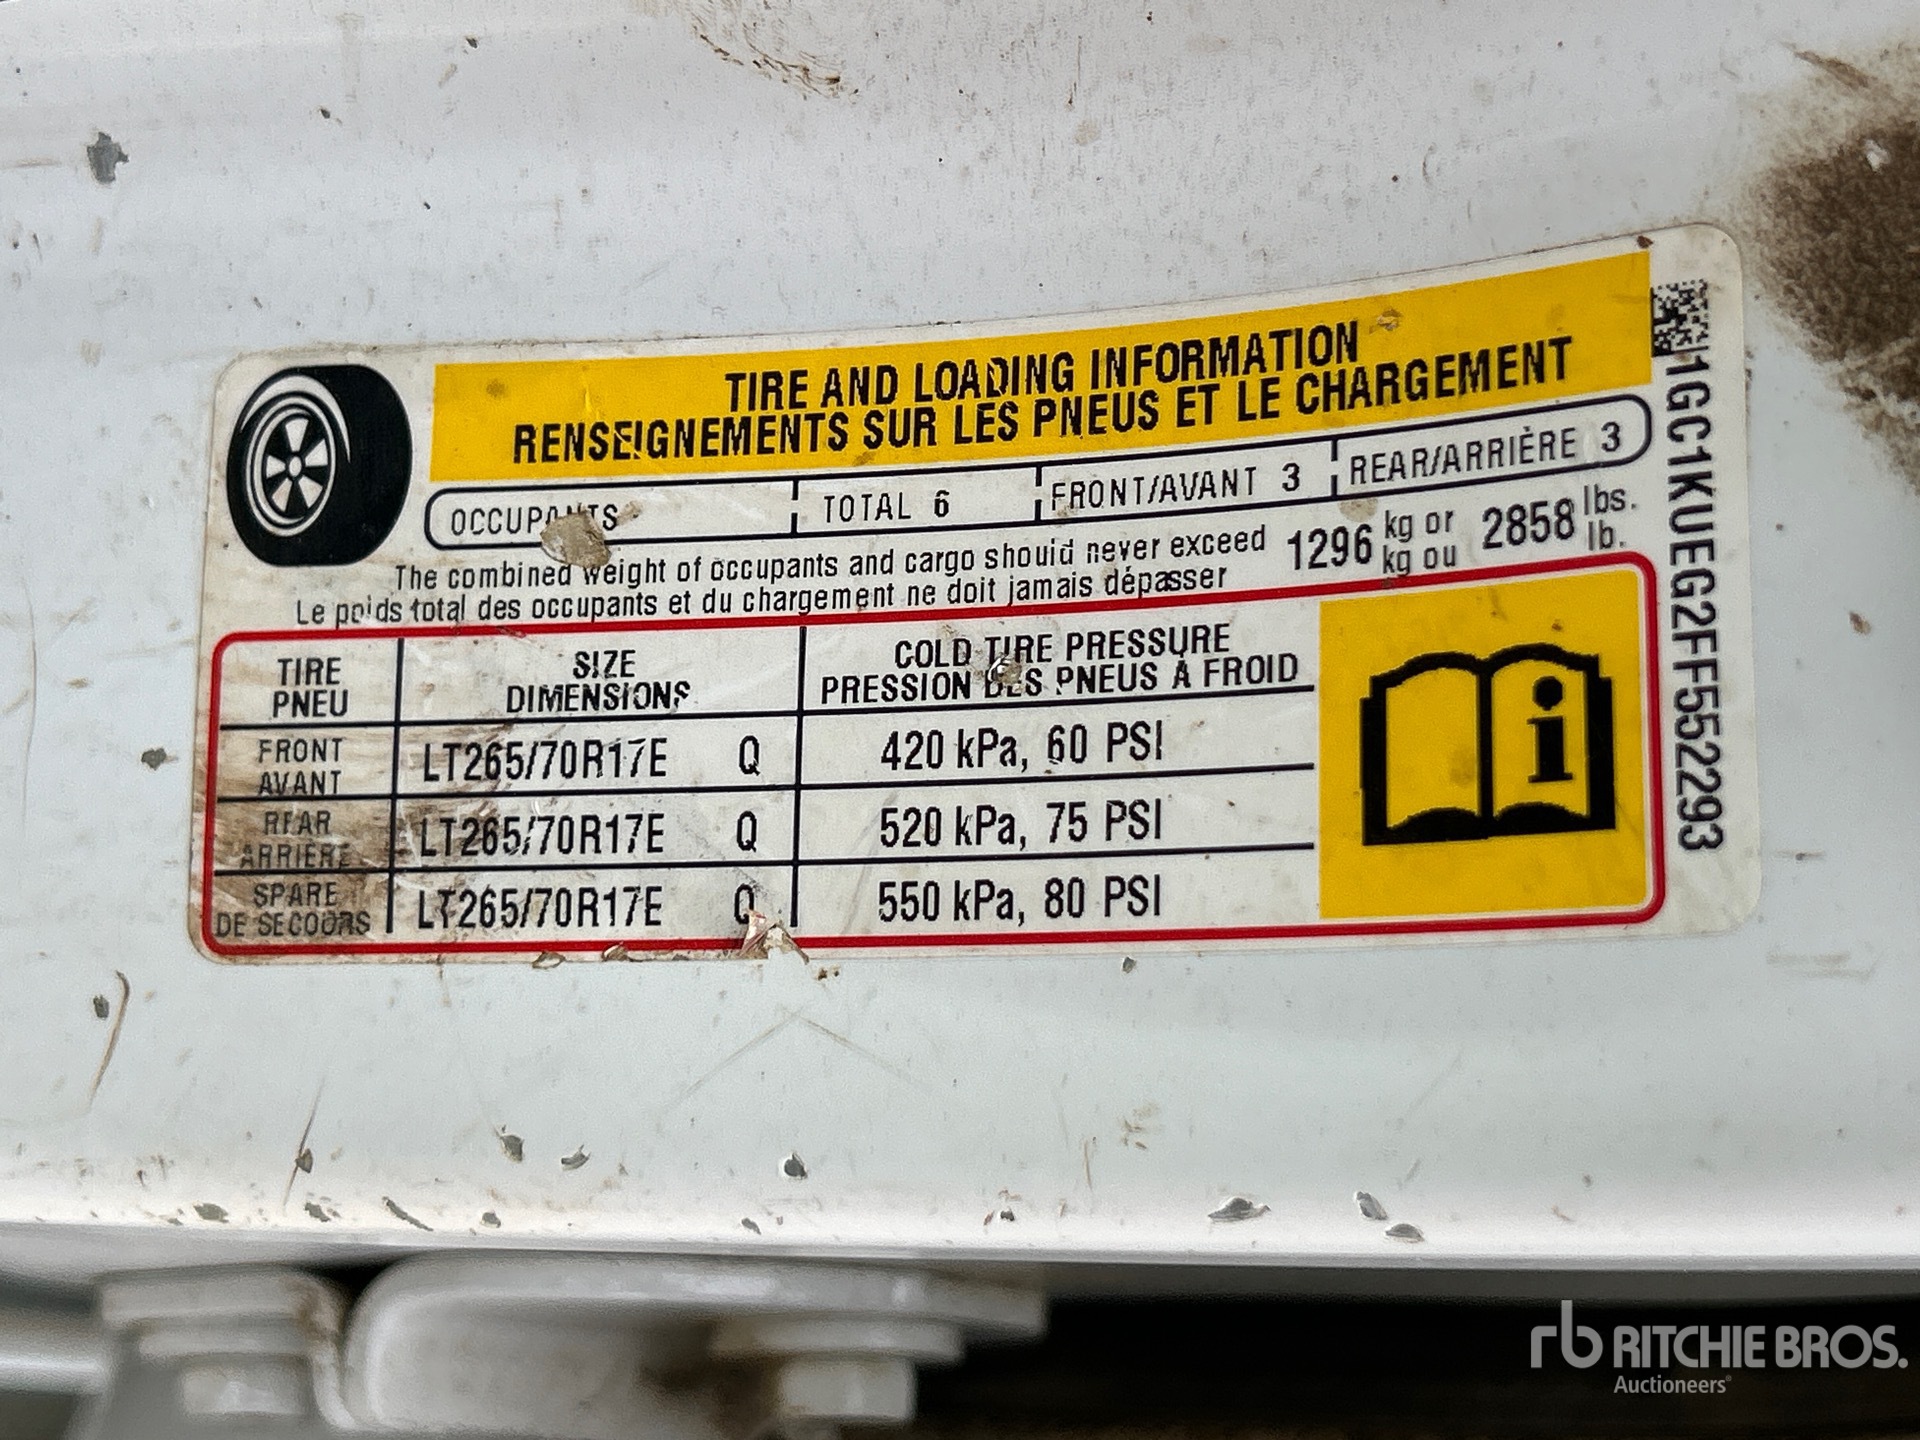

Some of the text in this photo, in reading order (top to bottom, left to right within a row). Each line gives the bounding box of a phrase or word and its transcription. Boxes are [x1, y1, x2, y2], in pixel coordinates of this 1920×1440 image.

[725, 320, 1359, 413] TIRE AND LOADING INFORMATION
[513, 335, 1573, 464] RENSEIGNEMENTS SUR LES PNEUS ET LE CHARGEMENT
[1350, 421, 1622, 486] REAR/ARRIÈRE 3
[823, 490, 950, 525] TOTAL 6
[1051, 462, 1301, 512] FRONT/AVANT 3
[396, 485, 1638, 590] The combined weight of occupants and cargo should never exceed 1296 kg or 2858 lbs.
[297, 520, 1626, 630] Le poids total des occupants et du chargement ne doit jamais dépasser kg ou lb.
[1664, 353, 1724, 852] 1GC1KUEG2FF552293
[572, 649, 636, 680] SIZE
[895, 623, 1230, 669] COLD TIRE PRESSURE
[277, 657, 342, 686] TIRE
[821, 671, 971, 704] PRESSION
[1057, 662, 1158, 696] PNEUS
[1203, 652, 1298, 687] FROID
[273, 689, 348, 718] PNEU
[506, 680, 691, 714] DIMENSIONS
[258, 738, 343, 763] FRONT
[423, 735, 761, 783] LT265/70R17E Q
[880, 720, 1163, 773] 420 kPa, 60 PSI
[258, 770, 342, 795] AVANT
[420, 810, 757, 857] LT265/70R17E Q
[879, 799, 1162, 850] 520 kPa, 75 PSI
[254, 881, 338, 907] SPARE
[418, 883, 755, 929] LT265/70R17E Q
[878, 874, 1161, 926] 550 kPa, 80 PSI
[215, 910, 371, 937] DE SECOURS
